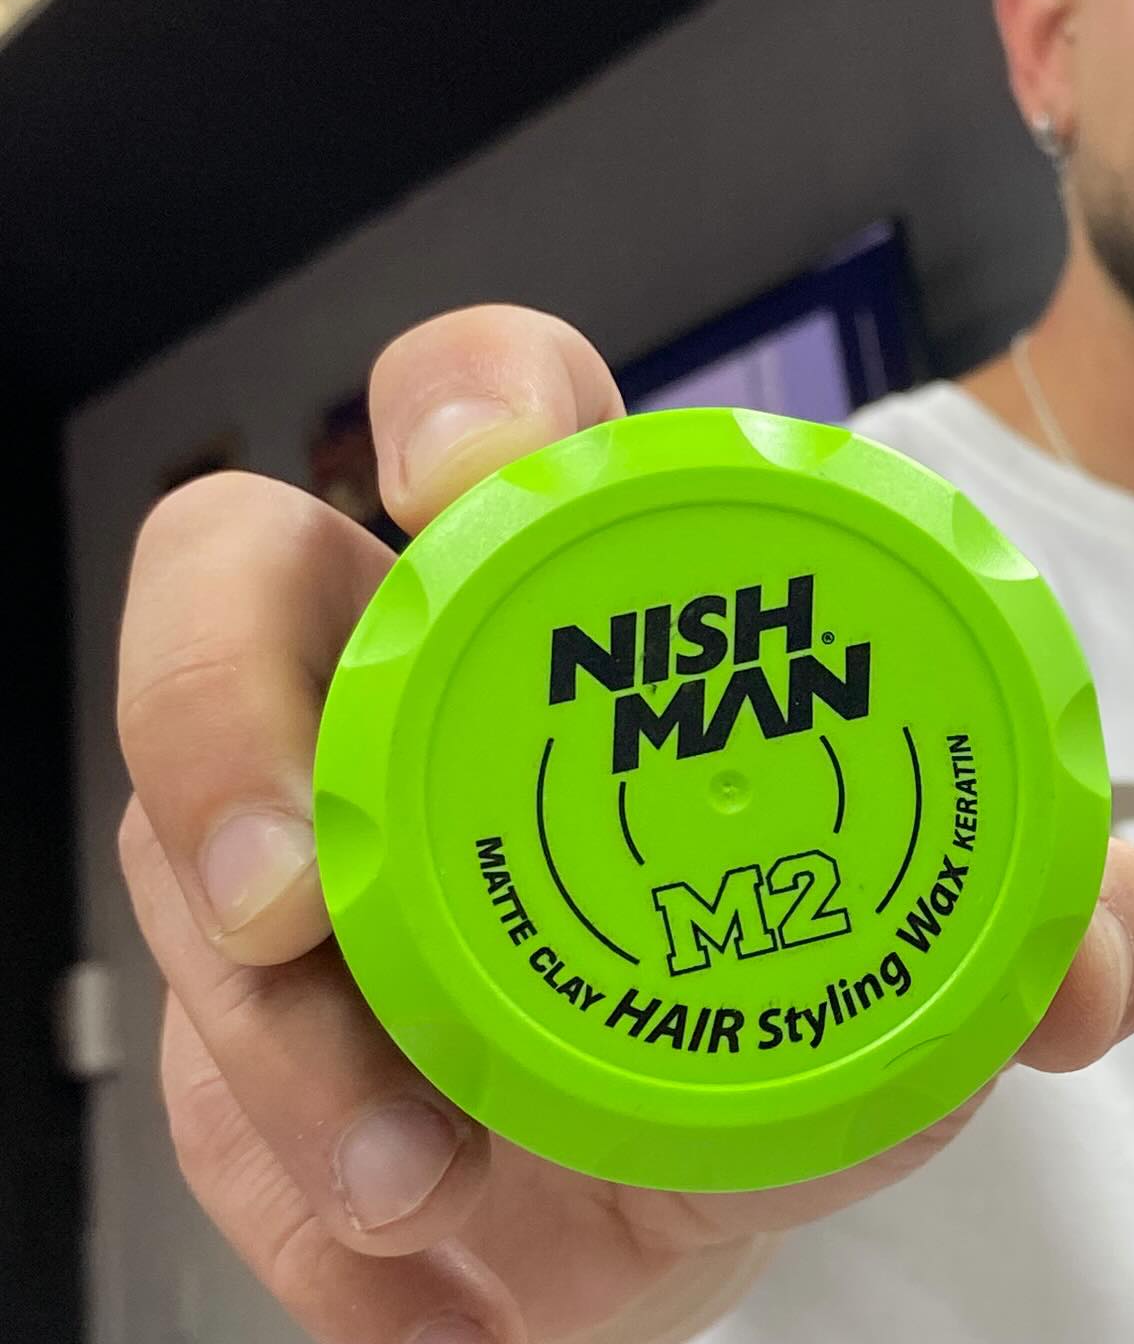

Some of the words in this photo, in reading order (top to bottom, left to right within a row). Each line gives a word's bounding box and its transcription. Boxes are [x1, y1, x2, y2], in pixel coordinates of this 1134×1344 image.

[548, 574, 814, 706] NISH
[611, 641, 871, 775] MAN
[474, 835, 538, 947] MATTE
[528, 945, 606, 1013] CLAY
[604, 987, 745, 1054] HAIR
[757, 951, 912, 1050] Styling
[895, 853, 970, 955] Wax
[945, 733, 979, 853] KERATIN
[651, 849, 852, 978] M2
